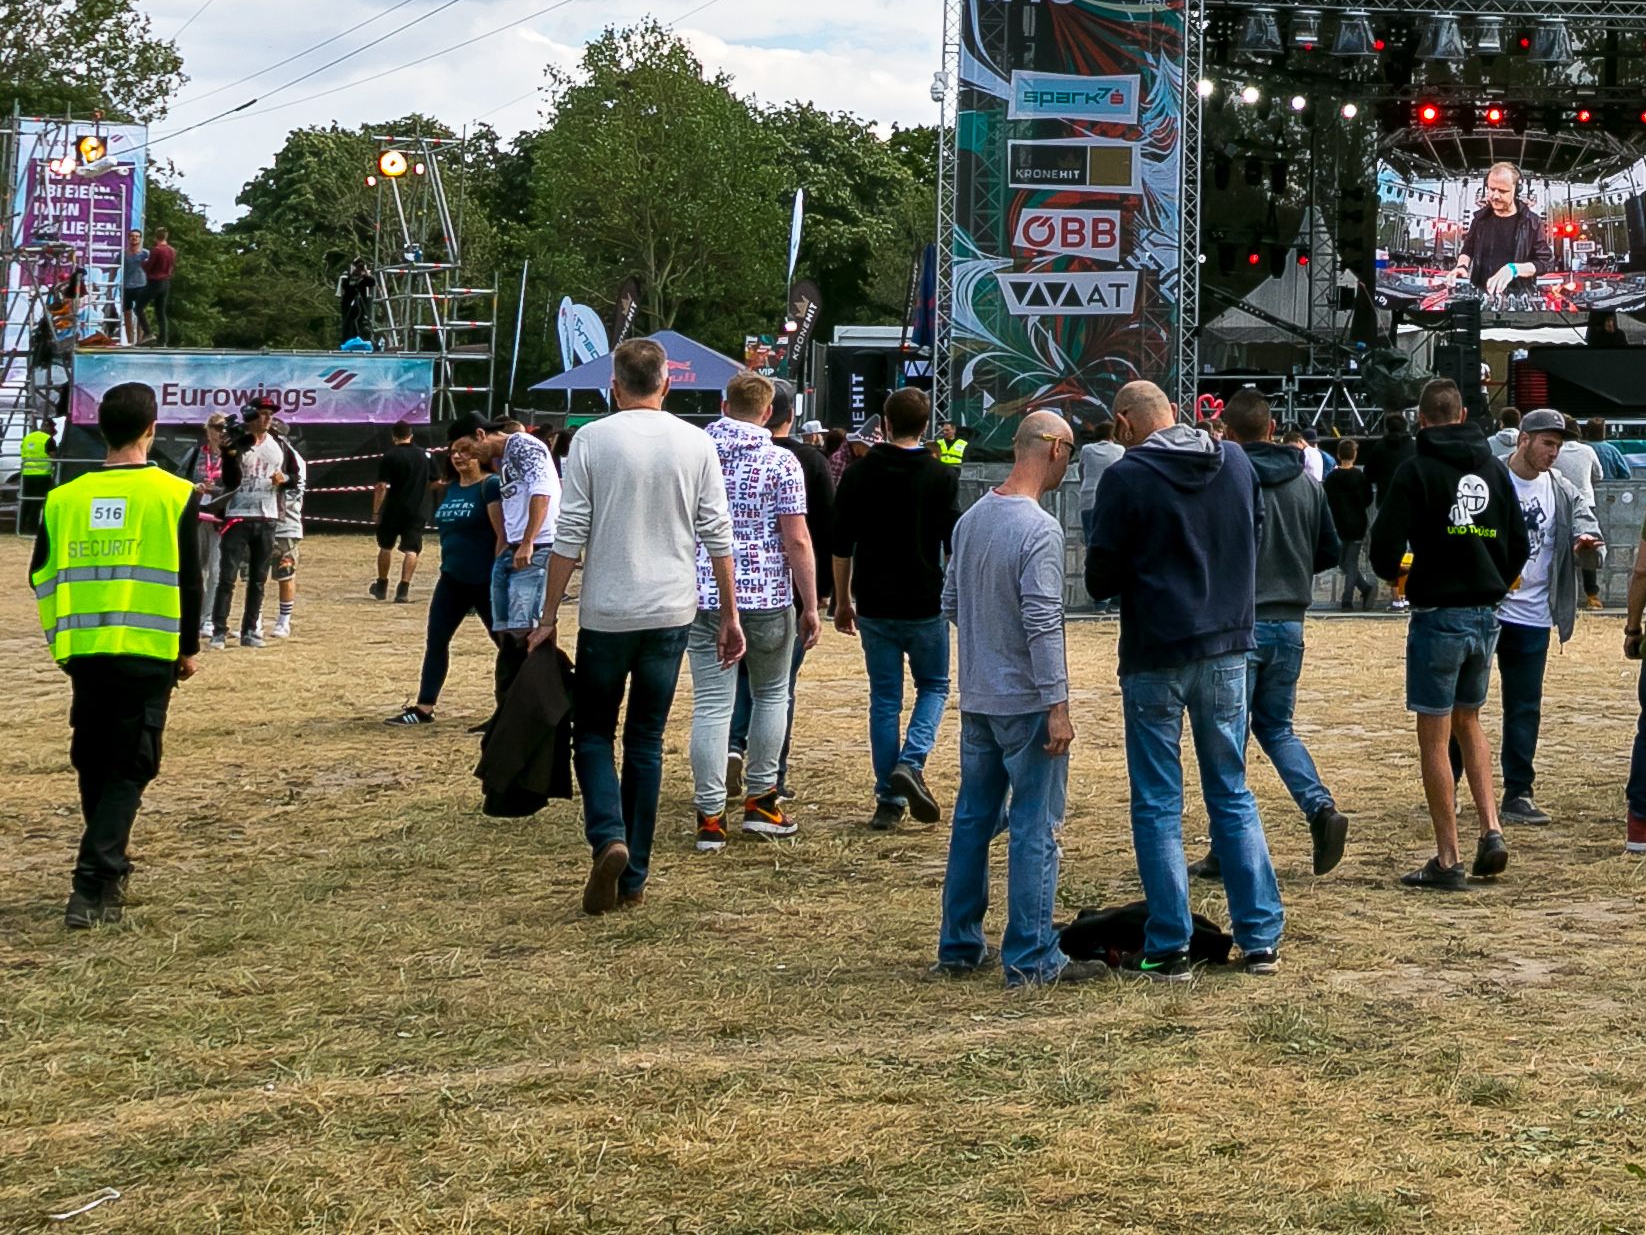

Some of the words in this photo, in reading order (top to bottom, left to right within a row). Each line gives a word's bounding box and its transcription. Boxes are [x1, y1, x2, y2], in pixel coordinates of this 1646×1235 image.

[1023, 87, 1113, 108] spark7
[1015, 168, 1081, 180] KRONEHIT
[1022, 215, 1117, 249] ÖBB
[792, 301, 819, 361] KRONEHIT
[758, 367, 775, 377] VIP
[161, 382, 318, 414] Eurowings
[94, 507, 122, 520] 516
[68, 538, 143, 559] SECURITY
